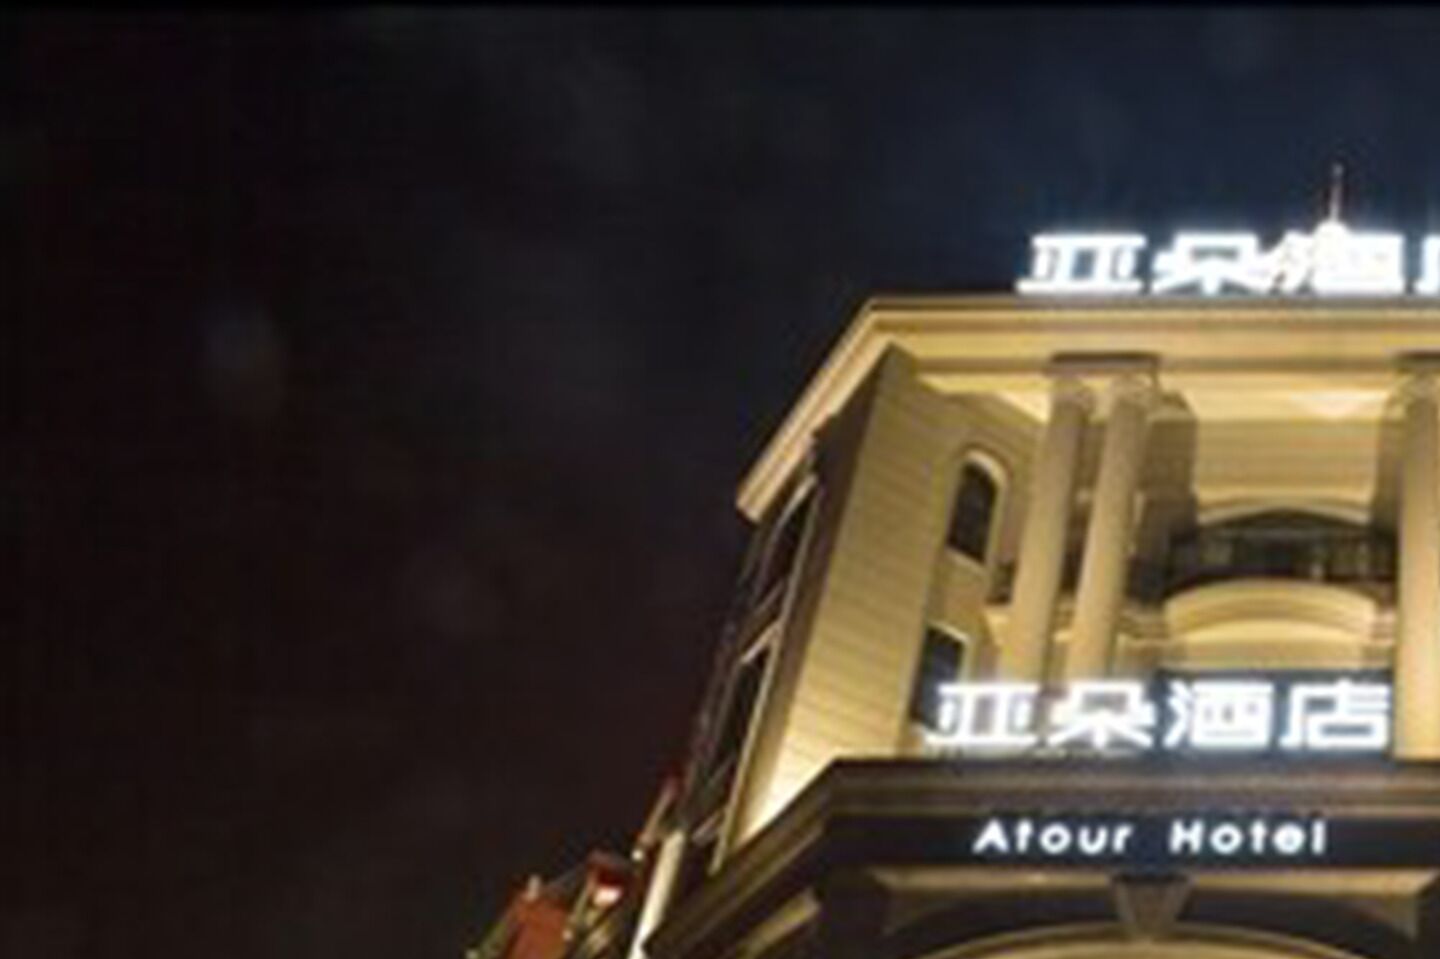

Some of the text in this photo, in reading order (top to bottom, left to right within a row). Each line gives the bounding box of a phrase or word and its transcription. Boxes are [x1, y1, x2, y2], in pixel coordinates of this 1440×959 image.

[922, 679, 1392, 751] 亚朵酒店
[972, 818, 1327, 855] Atour Hotel
